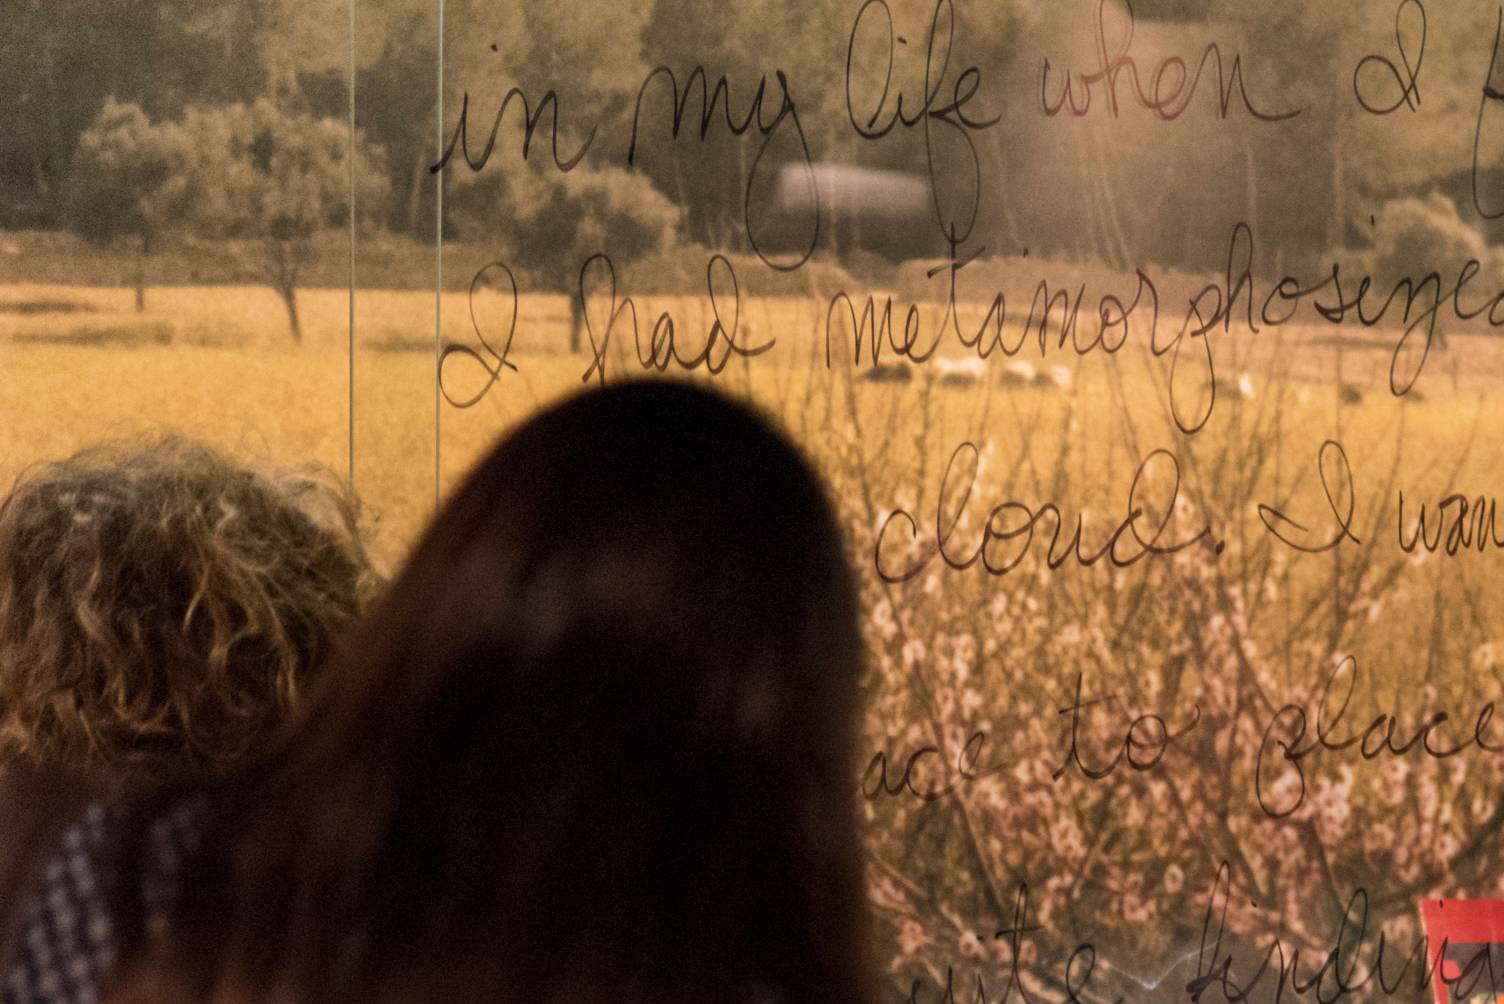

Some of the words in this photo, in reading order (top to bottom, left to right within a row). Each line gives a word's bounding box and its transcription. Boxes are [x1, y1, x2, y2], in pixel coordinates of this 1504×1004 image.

[430, 43, 598, 172] in
[627, 66, 820, 271] my
[846, 0, 1002, 244] life
[1042, 0, 1301, 121] when
[1353, 0, 1427, 114] I
[438, 262, 518, 409] I
[581, 253, 776, 382] had
[1258, 439, 1362, 552] I
[1053, 674, 1201, 779] to
